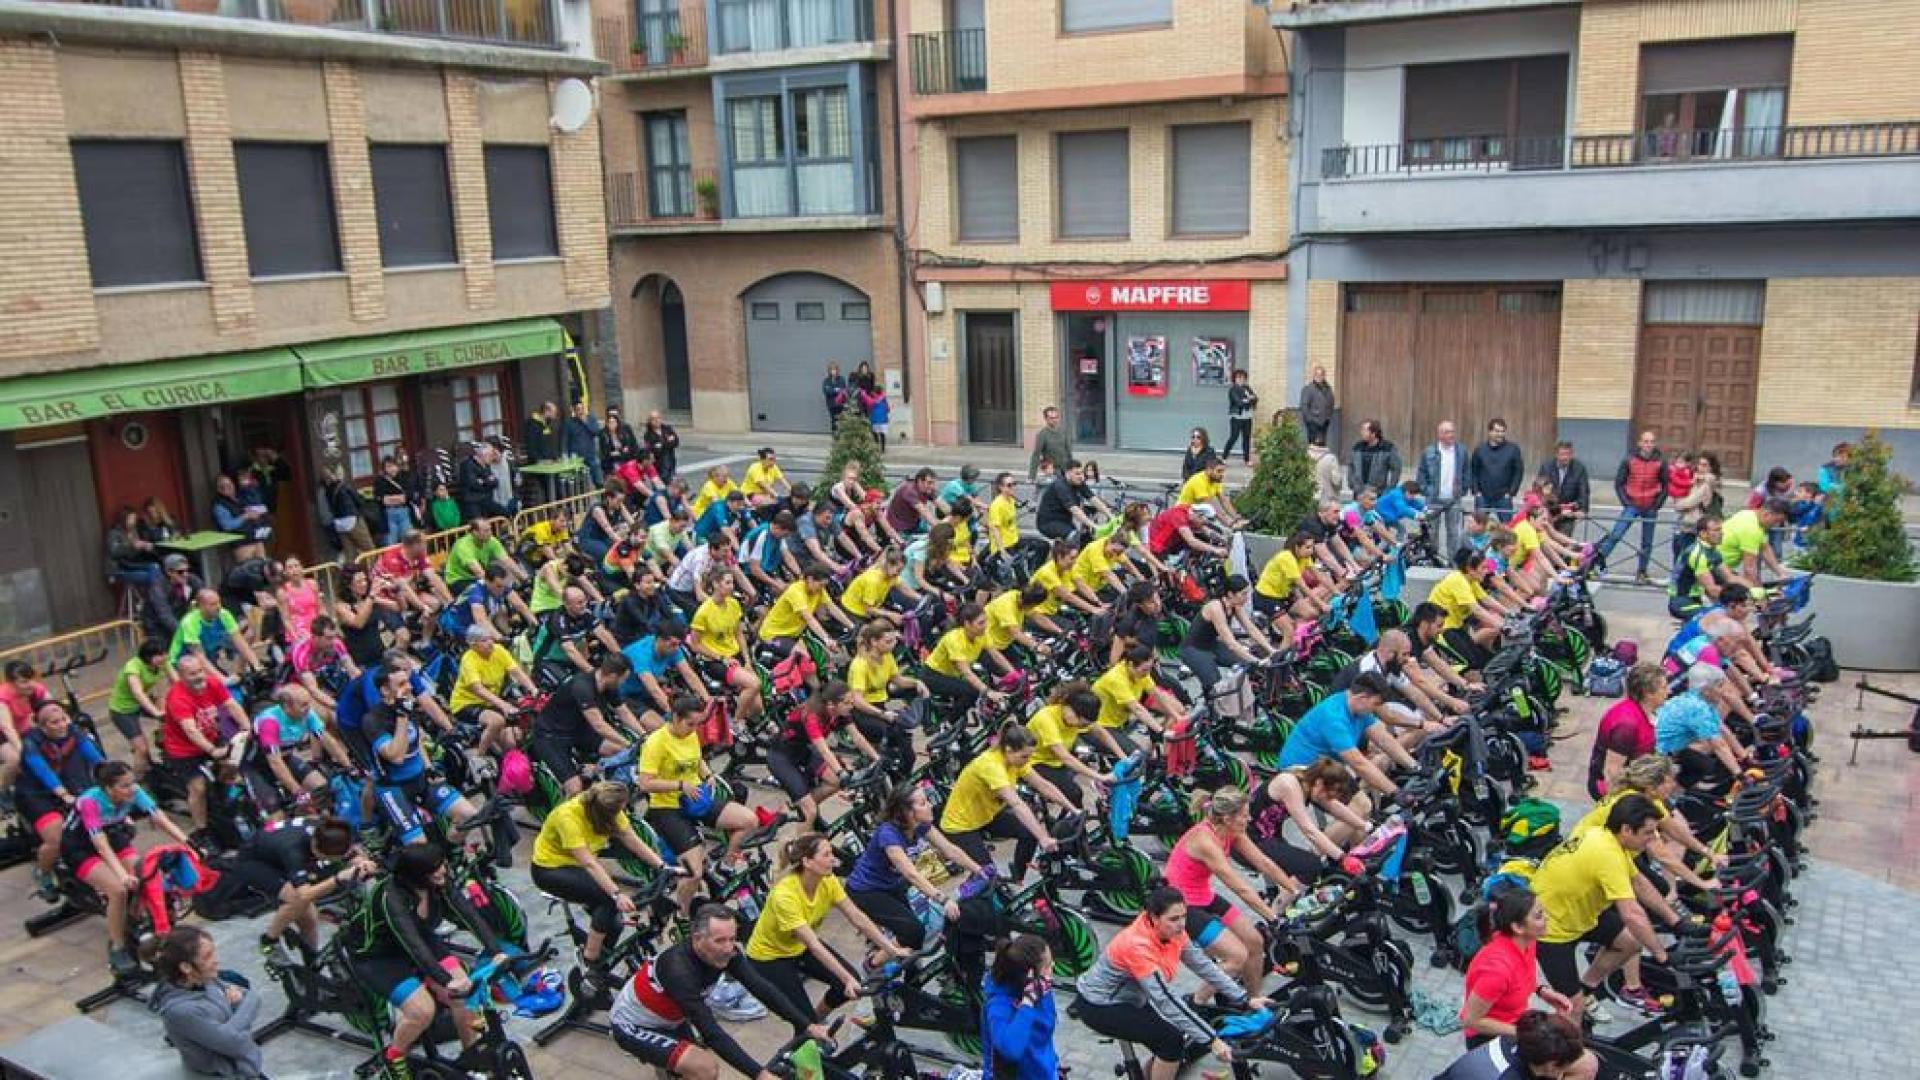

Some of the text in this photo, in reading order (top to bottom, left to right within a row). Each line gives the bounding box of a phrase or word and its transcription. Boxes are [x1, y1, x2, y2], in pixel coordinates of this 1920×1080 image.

[1111, 286, 1210, 304] MAPFRE
[371, 341, 512, 375] BAR EL CURICA
[21, 382, 228, 424] BAR EL CURICA
